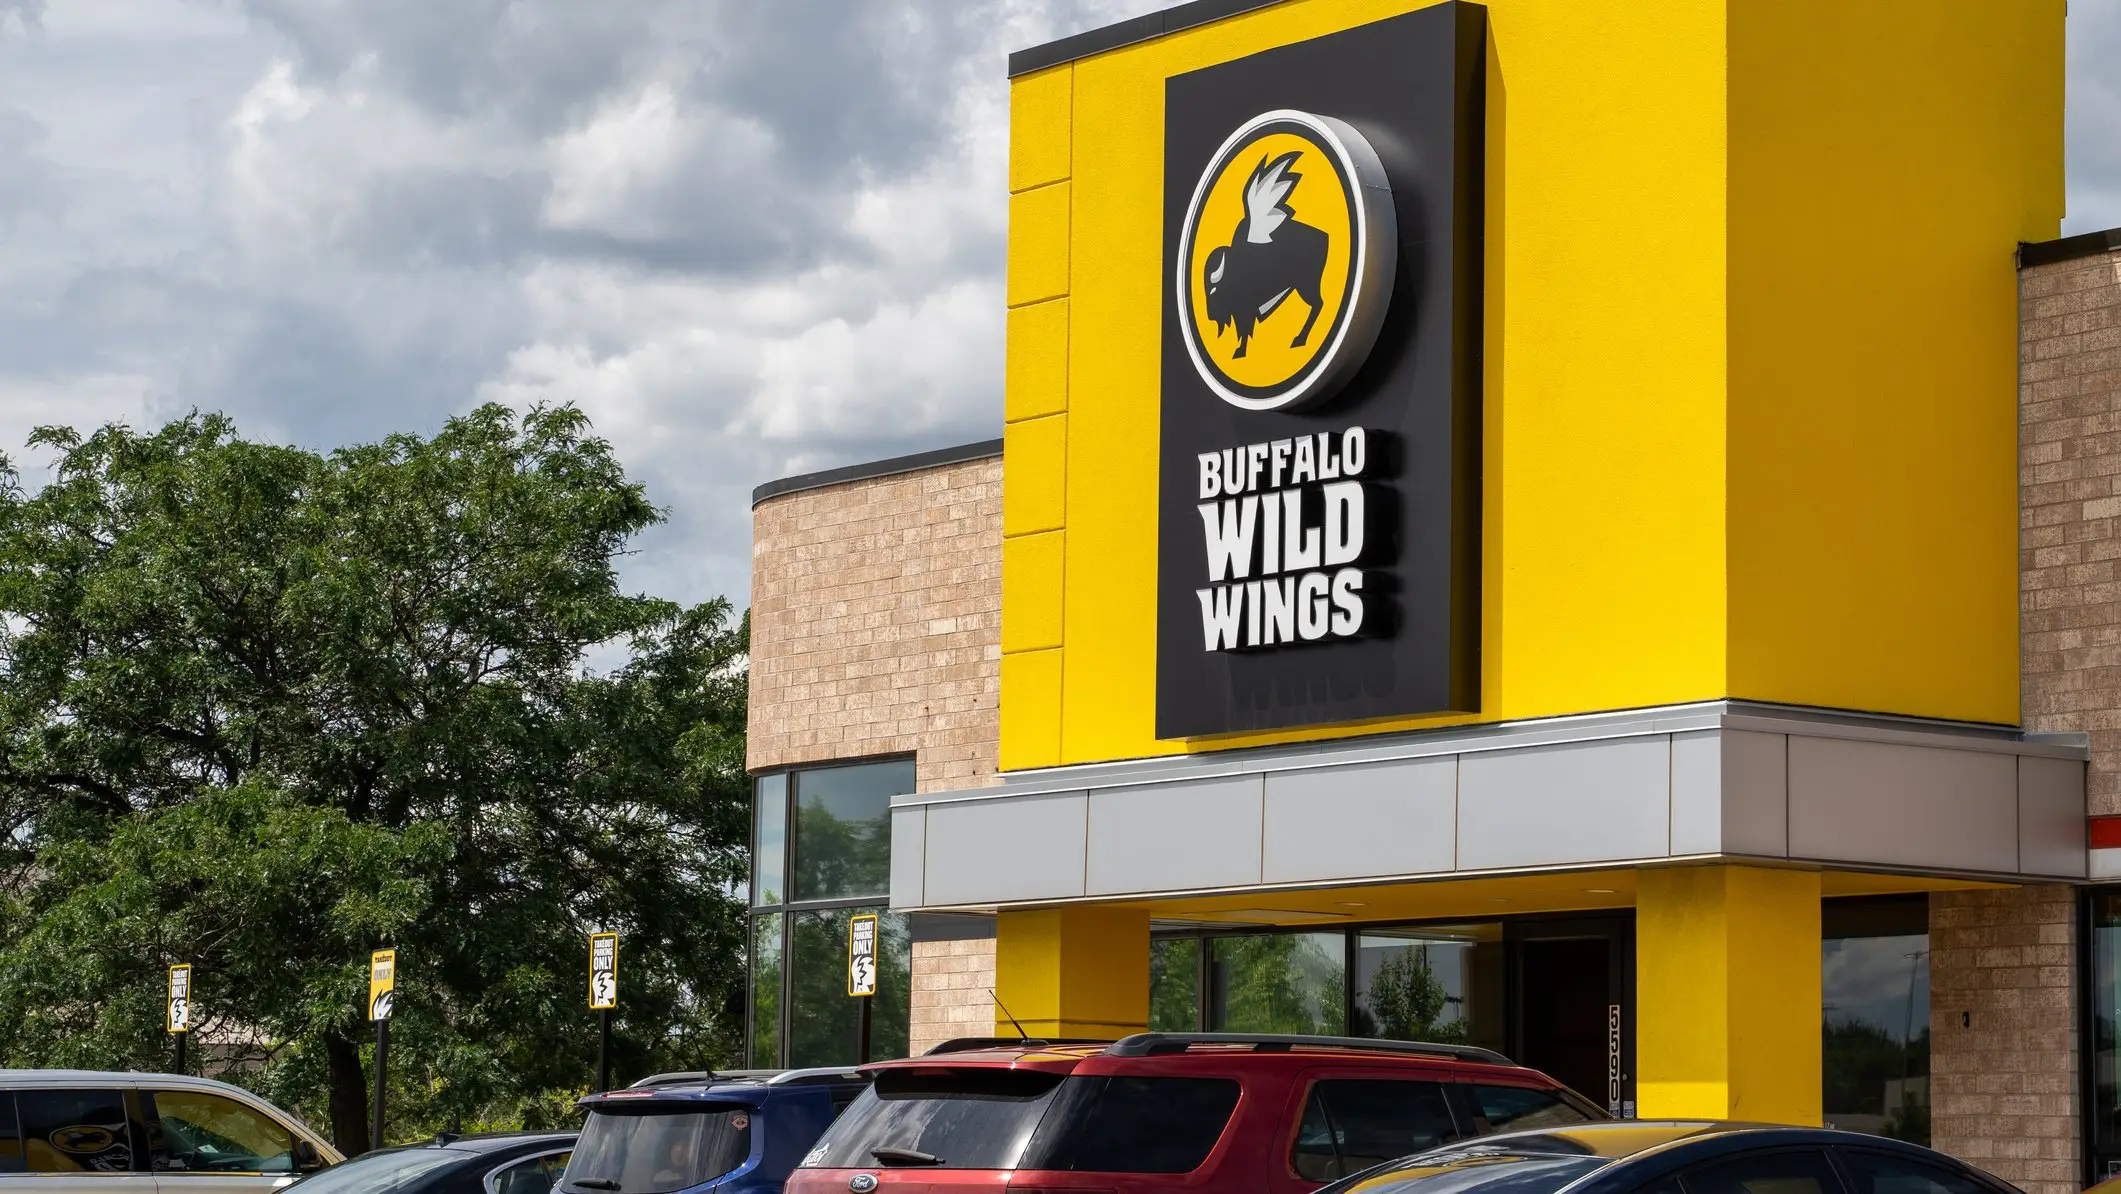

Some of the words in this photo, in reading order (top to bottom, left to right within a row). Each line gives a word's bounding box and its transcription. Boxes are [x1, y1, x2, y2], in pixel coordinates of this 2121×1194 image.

[1198, 426, 1365, 500] BUFFALO
[1197, 480, 1365, 582] WILD
[1196, 567, 1364, 652] WINGS
[853, 939, 873, 955] ONLY
[593, 955, 613, 970] ONLY
[374, 968, 392, 980] ONLY
[171, 985, 187, 998] ONLY
[1610, 1006, 1619, 1102] 5590
[852, 1176, 870, 1188] Ford
